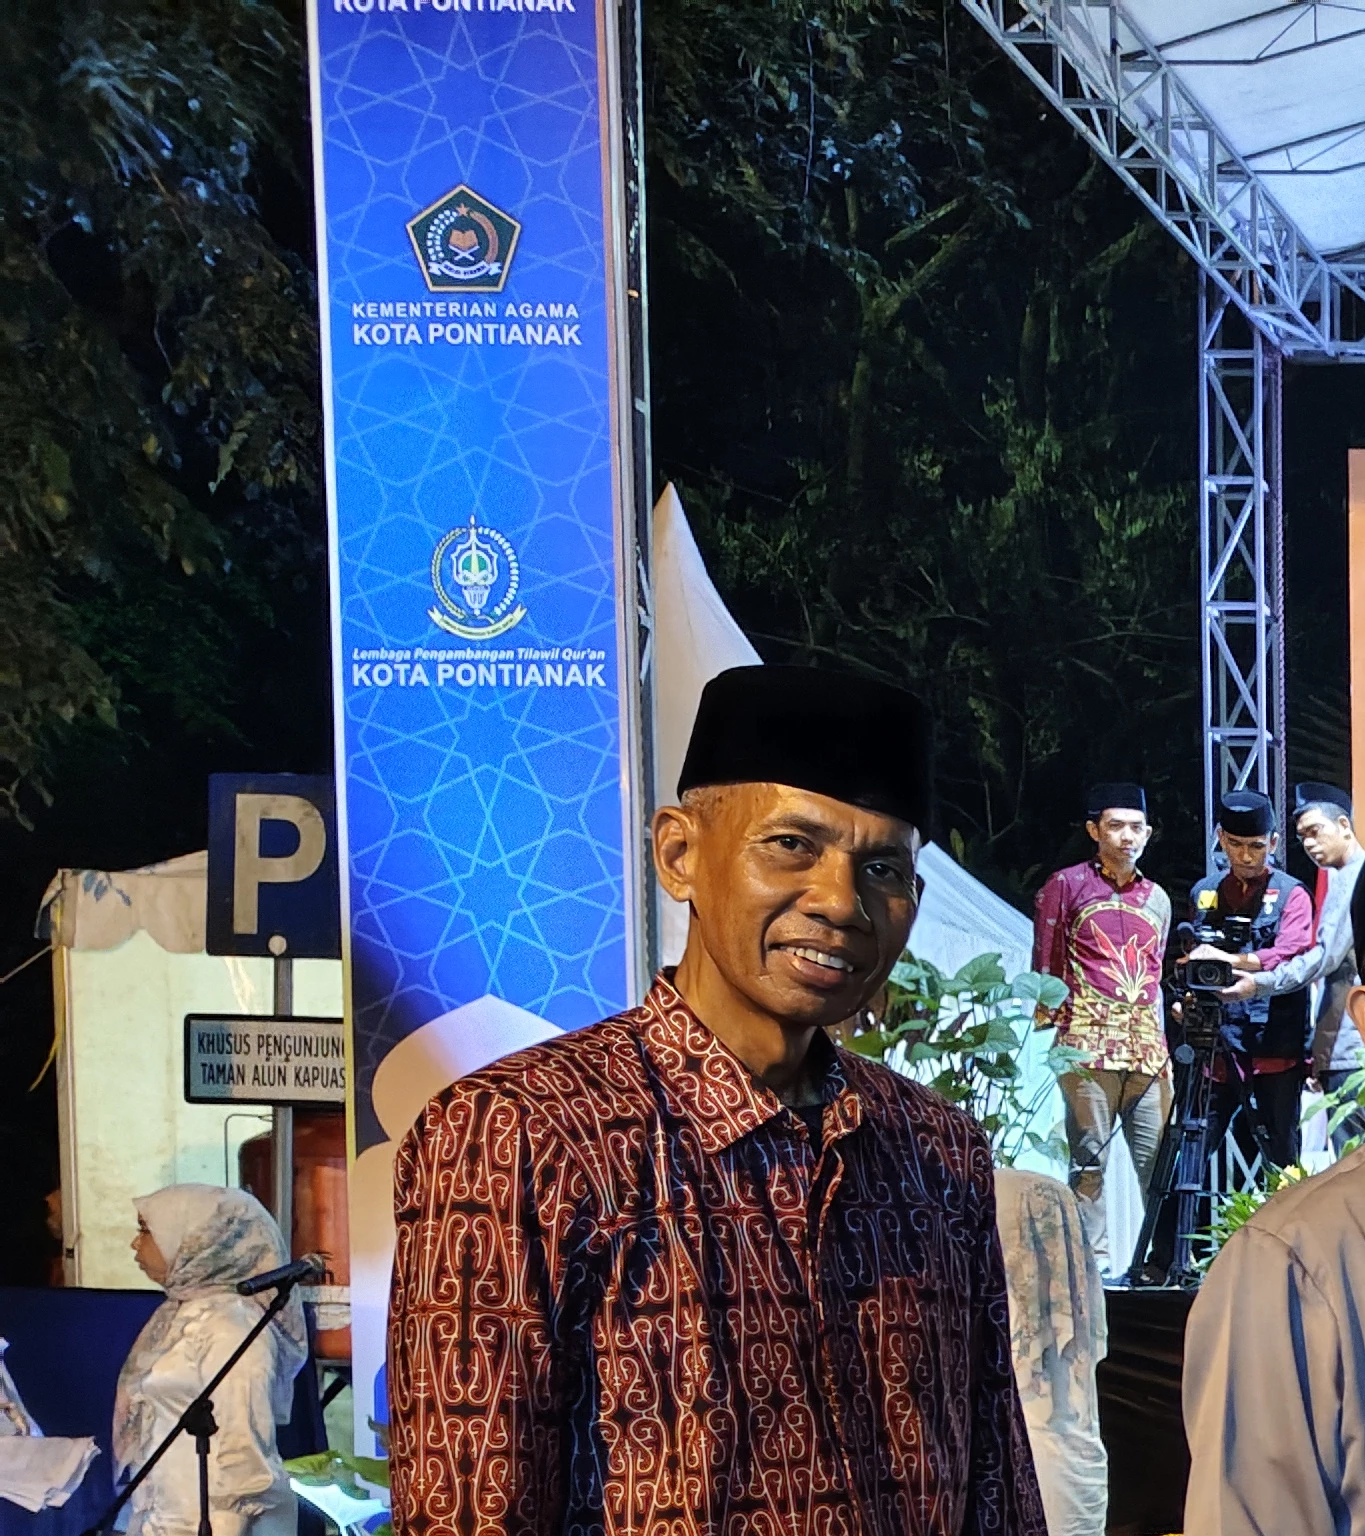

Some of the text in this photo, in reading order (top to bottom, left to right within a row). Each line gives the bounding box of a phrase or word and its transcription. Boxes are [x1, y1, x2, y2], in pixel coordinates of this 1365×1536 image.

[352, 302, 579, 319] KEMENTERIAN AGAMA
[353, 323, 582, 346] KOTA PONTIANAK
[352, 646, 411, 662] Lembaga
[561, 647, 606, 661] Qur'an
[352, 663, 607, 687] KOTA PONTIANAK
[233, 793, 326, 934] P
[198, 1032, 344, 1059] KHUSUS PENGUNJUN
[201, 1063, 345, 1089] TAMAN ALUN KAPUAS
